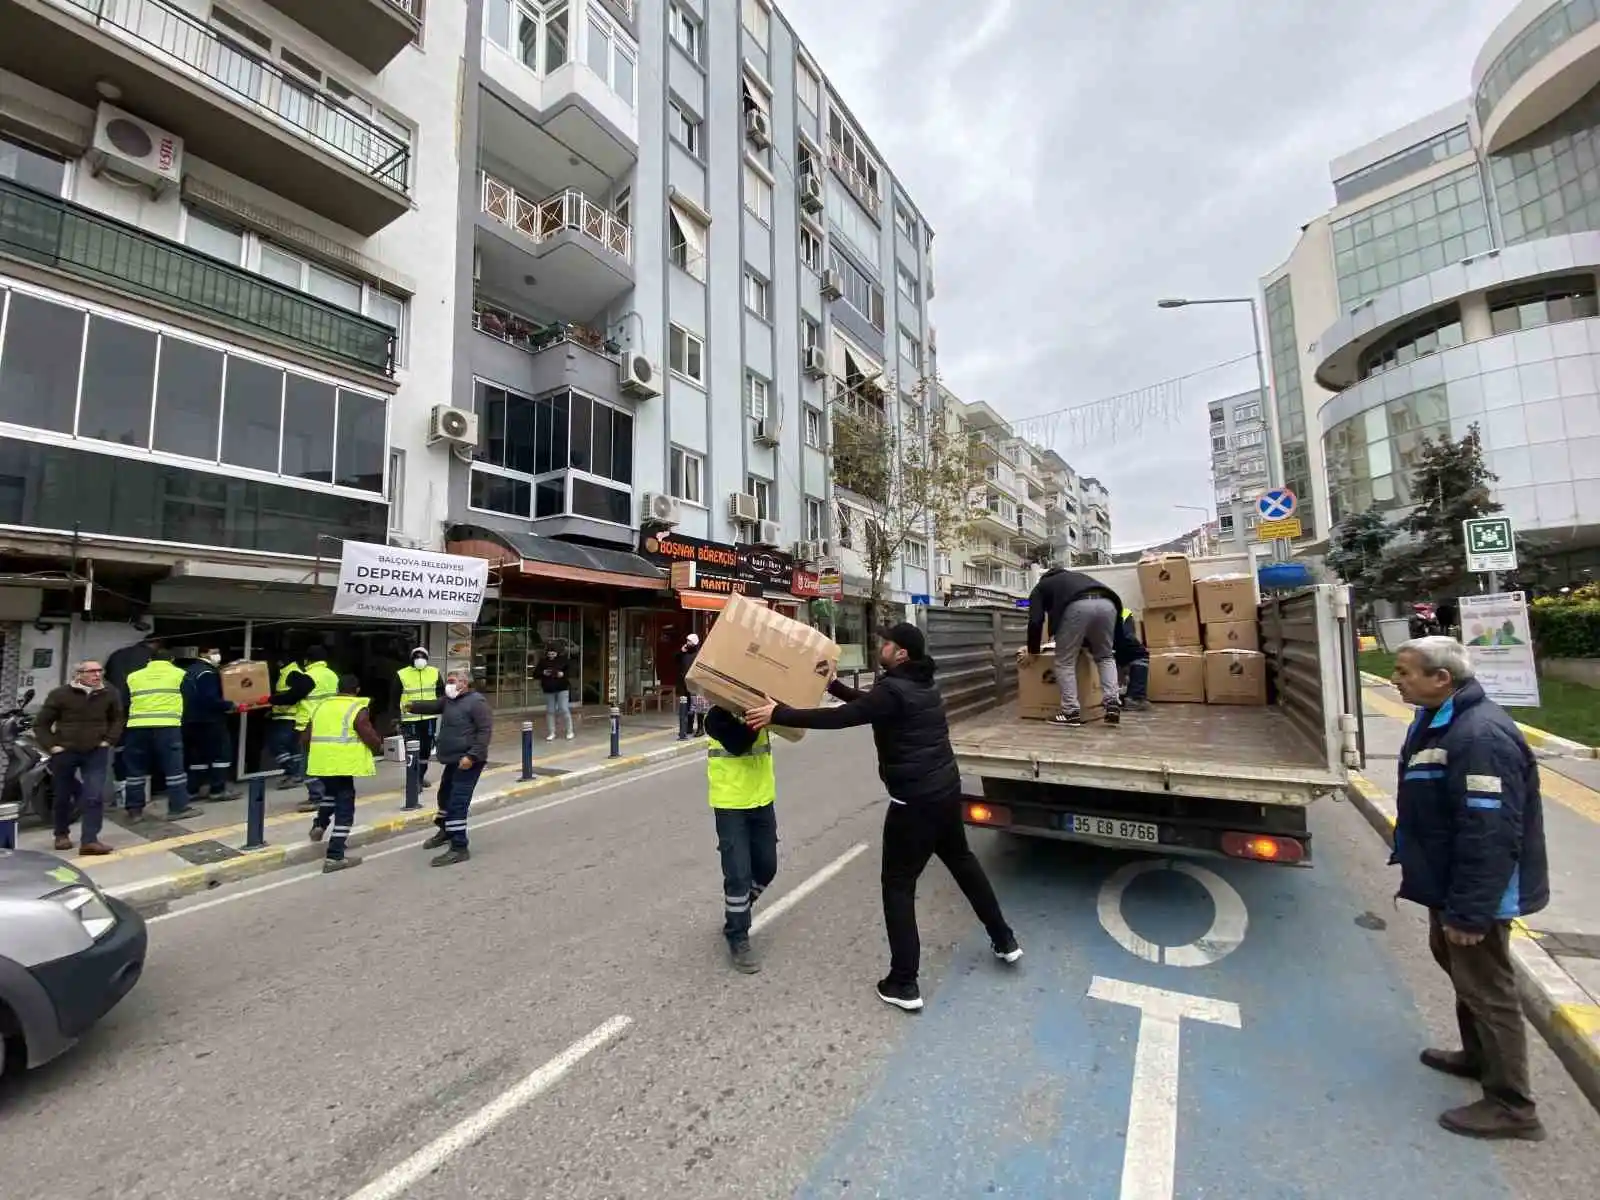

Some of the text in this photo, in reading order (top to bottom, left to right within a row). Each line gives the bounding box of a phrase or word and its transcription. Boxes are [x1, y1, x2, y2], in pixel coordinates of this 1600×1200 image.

[660, 540, 695, 558] BOŞNAK
[378, 555, 419, 566] BALÇOVA
[357, 566, 478, 588] DEPREM YARDIM
[701, 578, 730, 592] MANTI
[344, 582, 481, 603] TOPLAMA MERKEZİ
[1074, 816, 1090, 832] 35
[1120, 822, 1155, 841] 8766
